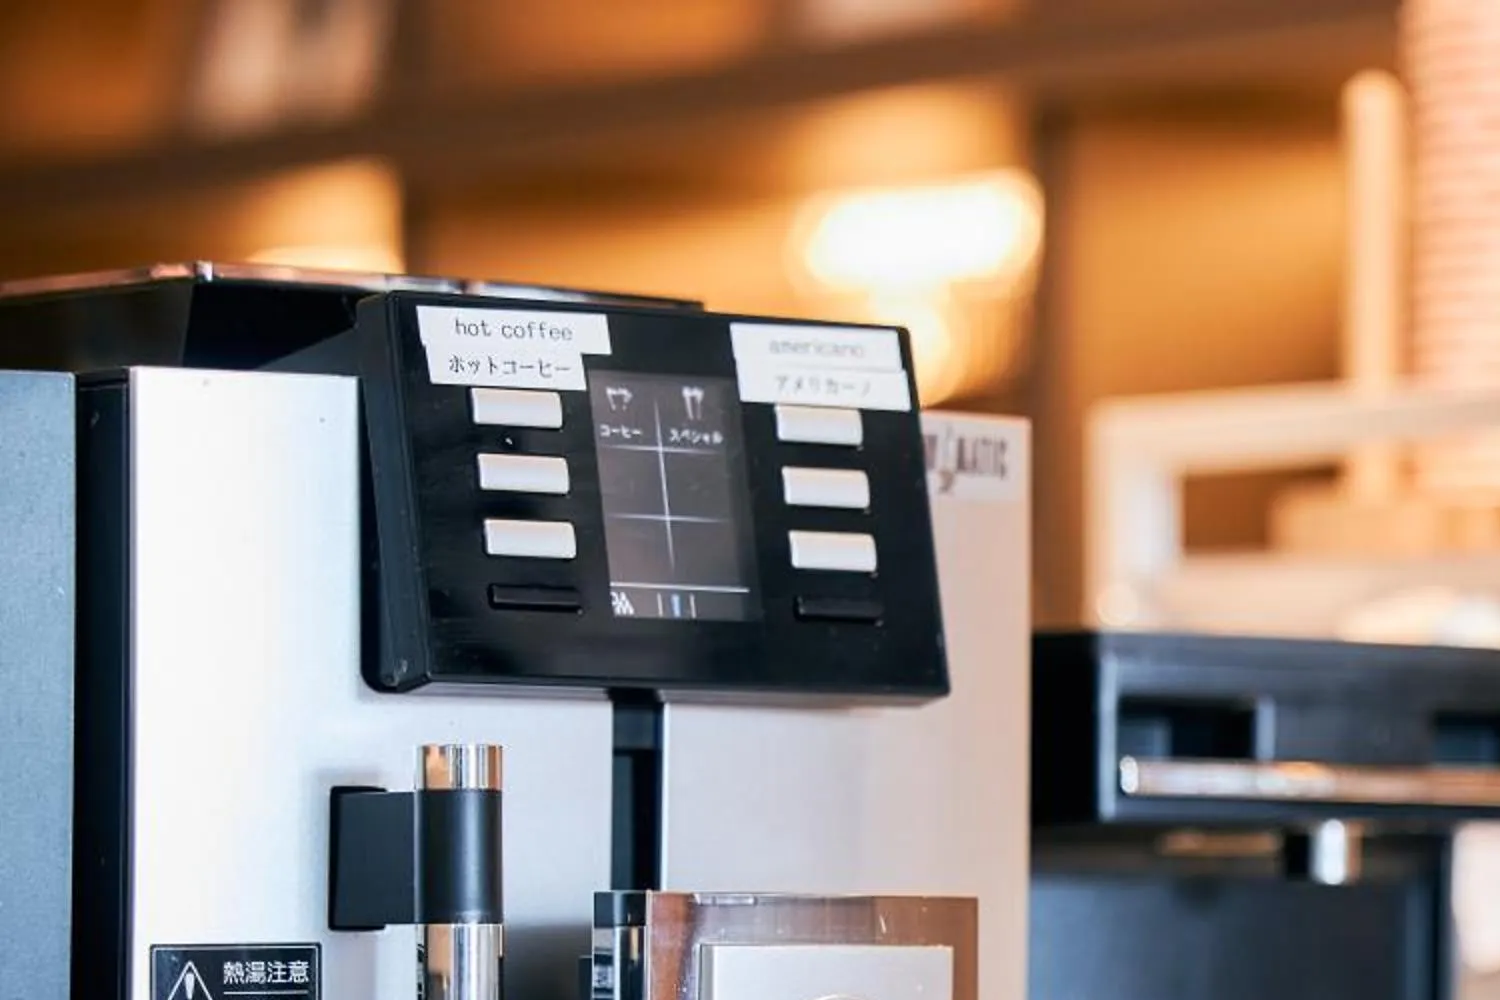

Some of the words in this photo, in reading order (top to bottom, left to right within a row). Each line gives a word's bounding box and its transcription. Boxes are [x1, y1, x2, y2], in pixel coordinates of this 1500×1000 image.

[454, 317, 492, 338] hot
[500, 321, 574, 342] coffee
[448, 353, 573, 378] ホットコーヒー
[600, 423, 643, 439] コーヒー
[222, 959, 310, 985] 熱湯注意
